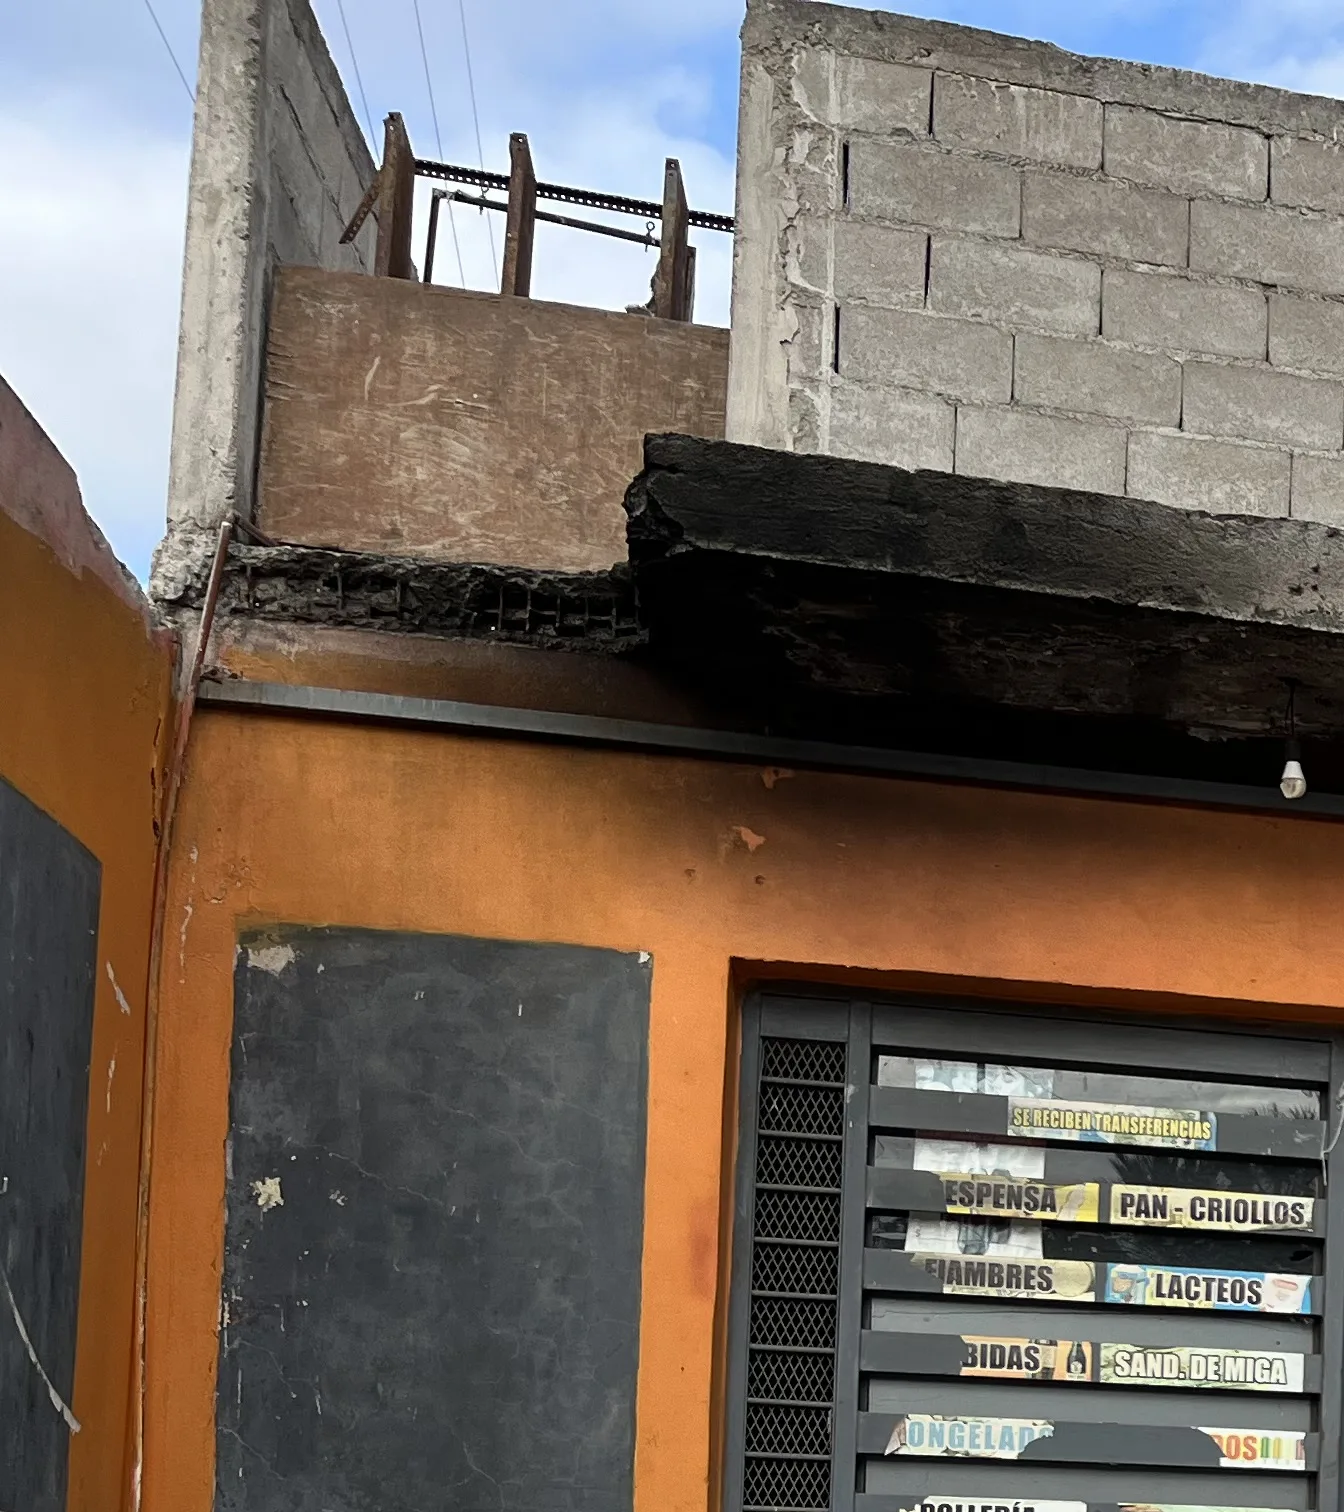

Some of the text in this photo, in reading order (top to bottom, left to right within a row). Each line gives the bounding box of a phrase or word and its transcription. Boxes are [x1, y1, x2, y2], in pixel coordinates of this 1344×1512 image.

[1013, 1108, 1211, 1140] SE RECIBEN TRANSFERENCIAS
[1120, 1192, 1168, 1220] PAN
[1190, 1196, 1305, 1225] CRIOLLOS
[1155, 1273, 1263, 1305] LACTEOS
[1114, 1350, 1287, 1385] SAND. DE MIGA
[1211, 1434, 1258, 1461] OS
